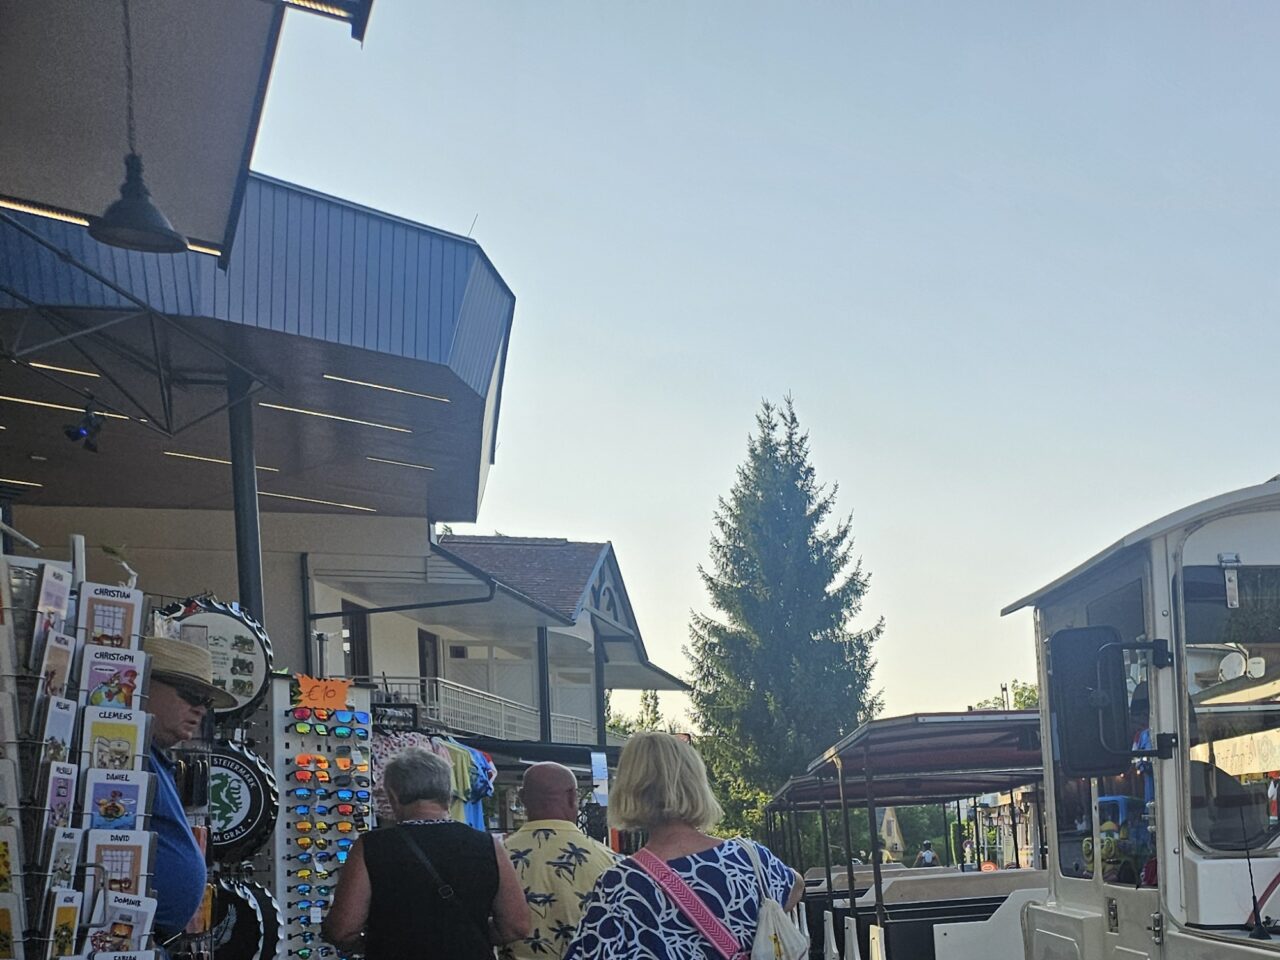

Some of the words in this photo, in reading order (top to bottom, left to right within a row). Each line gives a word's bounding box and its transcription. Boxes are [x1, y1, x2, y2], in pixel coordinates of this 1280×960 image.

[94, 588, 131, 599] CHRISTIAN
[94, 651, 135, 663] CHRISTOPH
[98, 711, 133, 721] CLEMENS
[106, 773, 130, 782] DANIEL
[213, 758, 257, 789] STEIERMARK
[110, 834, 130, 842] DAVID
[223, 825, 247, 841] GRAZ
[113, 896, 143, 908] DOMINIK
